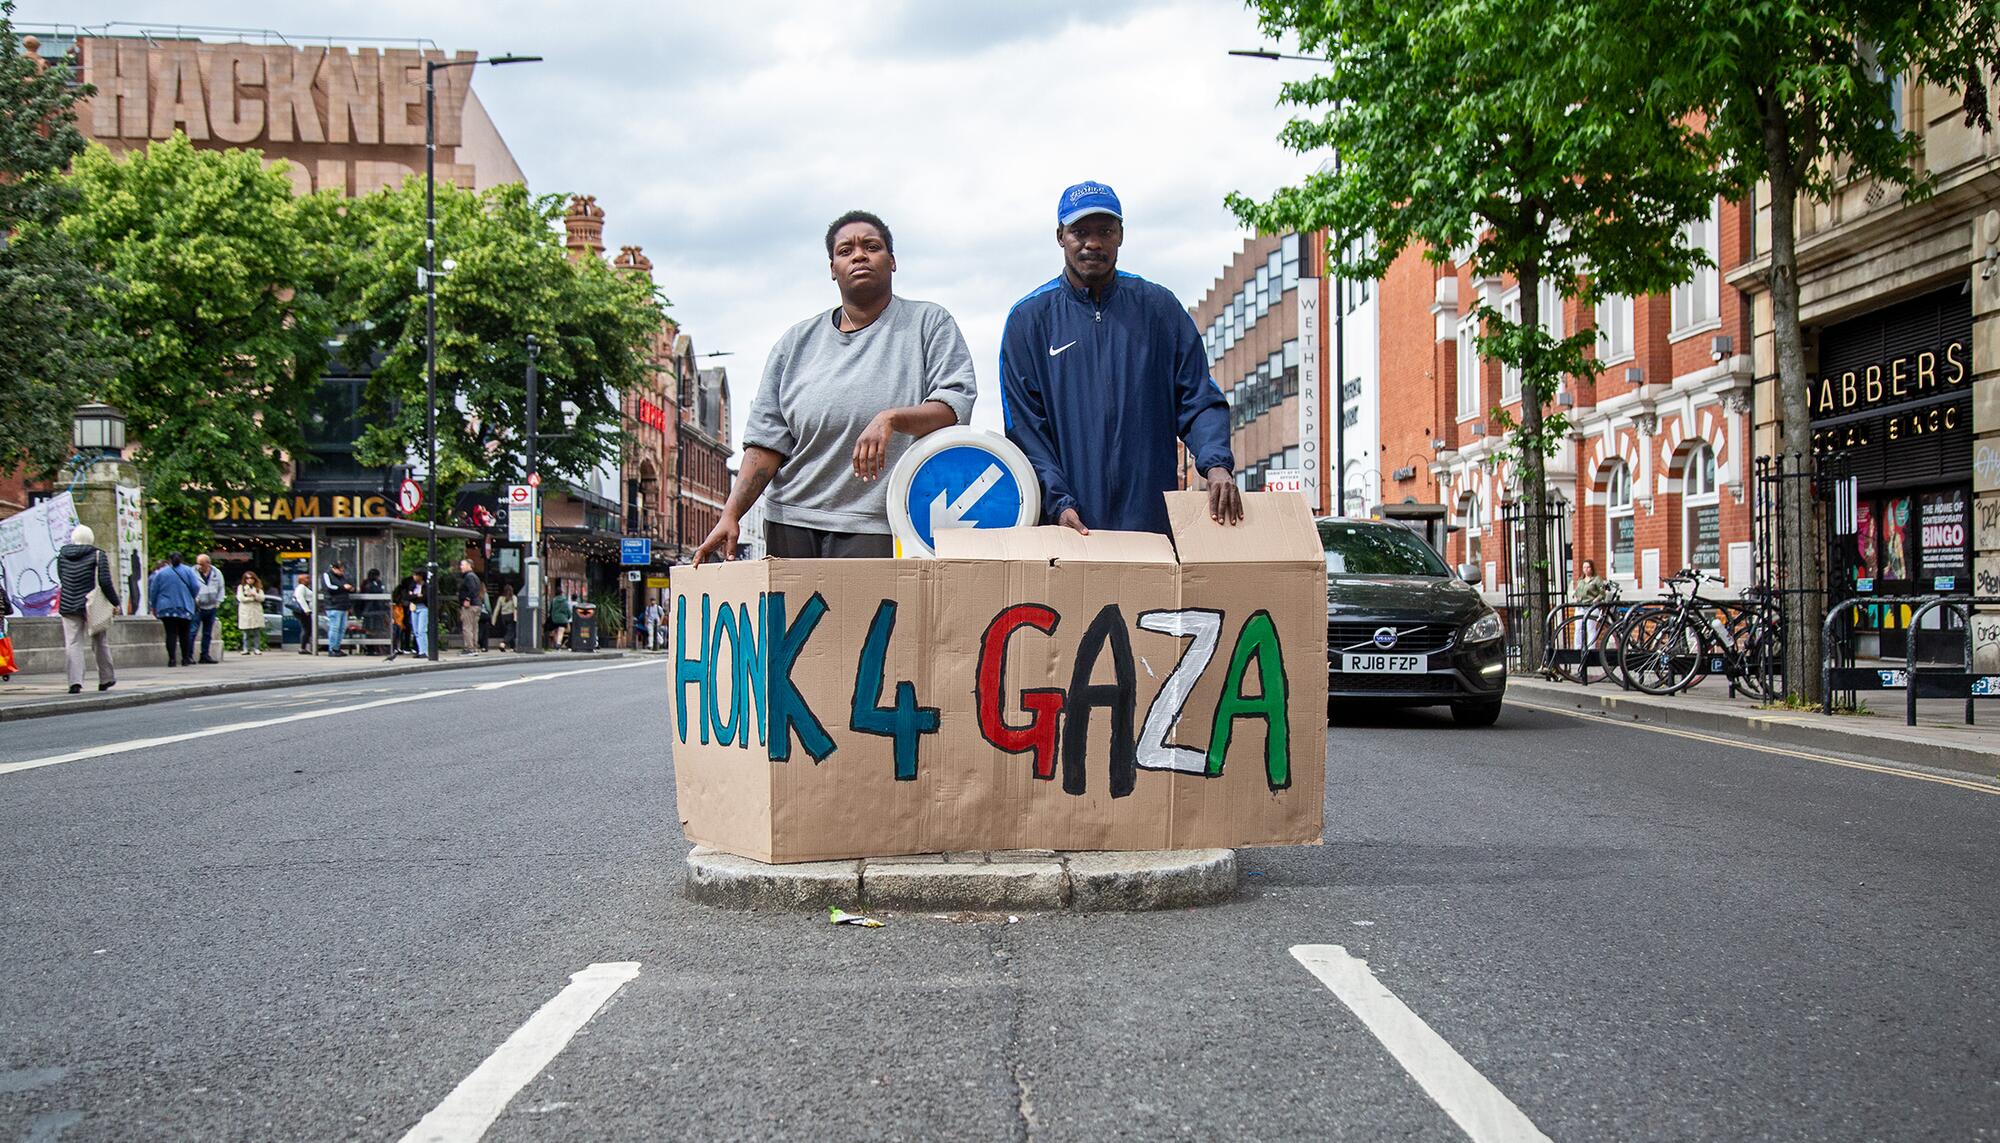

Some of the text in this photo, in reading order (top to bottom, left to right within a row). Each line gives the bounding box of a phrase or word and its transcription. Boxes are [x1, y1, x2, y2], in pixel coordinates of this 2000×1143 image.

[92, 39, 479, 147] HACKNEY
[1806, 342, 1964, 413] ABBERS
[1301, 299, 1317, 488] WETHERSPOON
[1268, 481, 1284, 492] TO
[207, 495, 388, 520] DREAM BIG
[1922, 501, 1964, 514] THE HOME OF
[1922, 514, 1964, 525] CONTEMPORARY
[1922, 524, 1964, 547] BINGO
[1351, 656, 1418, 671] RJ18 FZP
[676, 591, 1292, 799] HONK 4 GAZA
